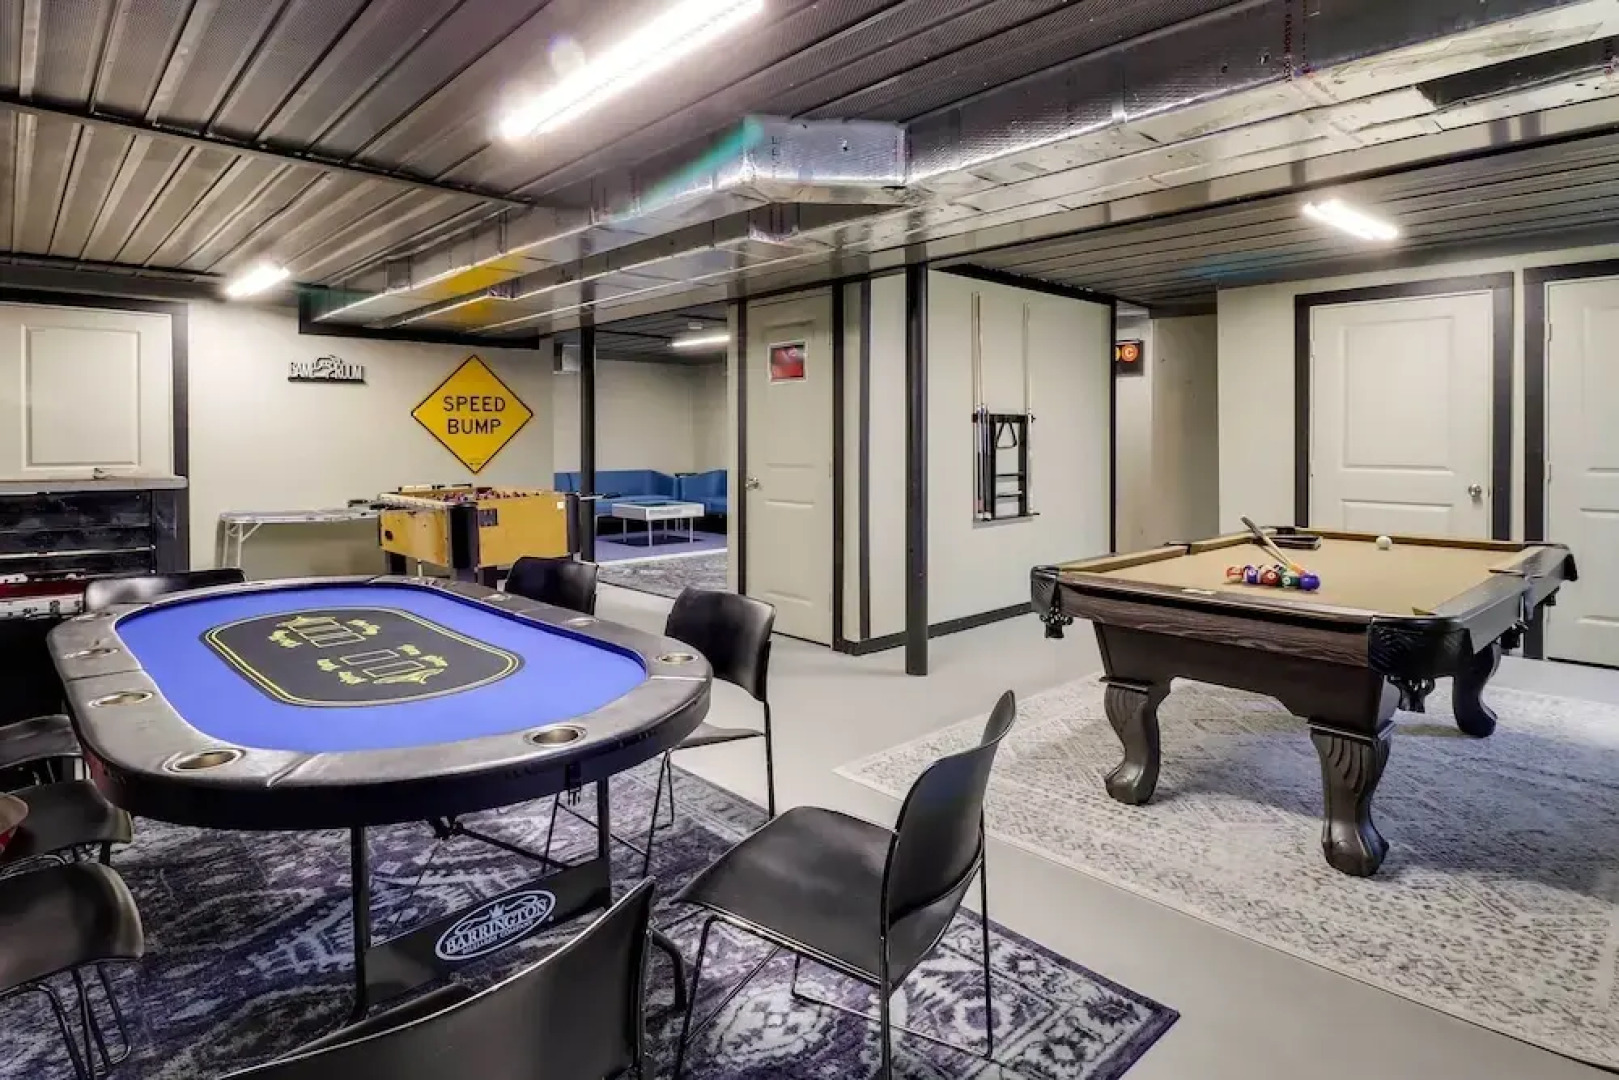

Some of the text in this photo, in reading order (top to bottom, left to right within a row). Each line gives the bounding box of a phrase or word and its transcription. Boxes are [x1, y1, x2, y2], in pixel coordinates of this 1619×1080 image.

[443, 395, 506, 412] SPEED
[447, 418, 502, 435] BUMP
[445, 898, 547, 955] BARRINGTON
